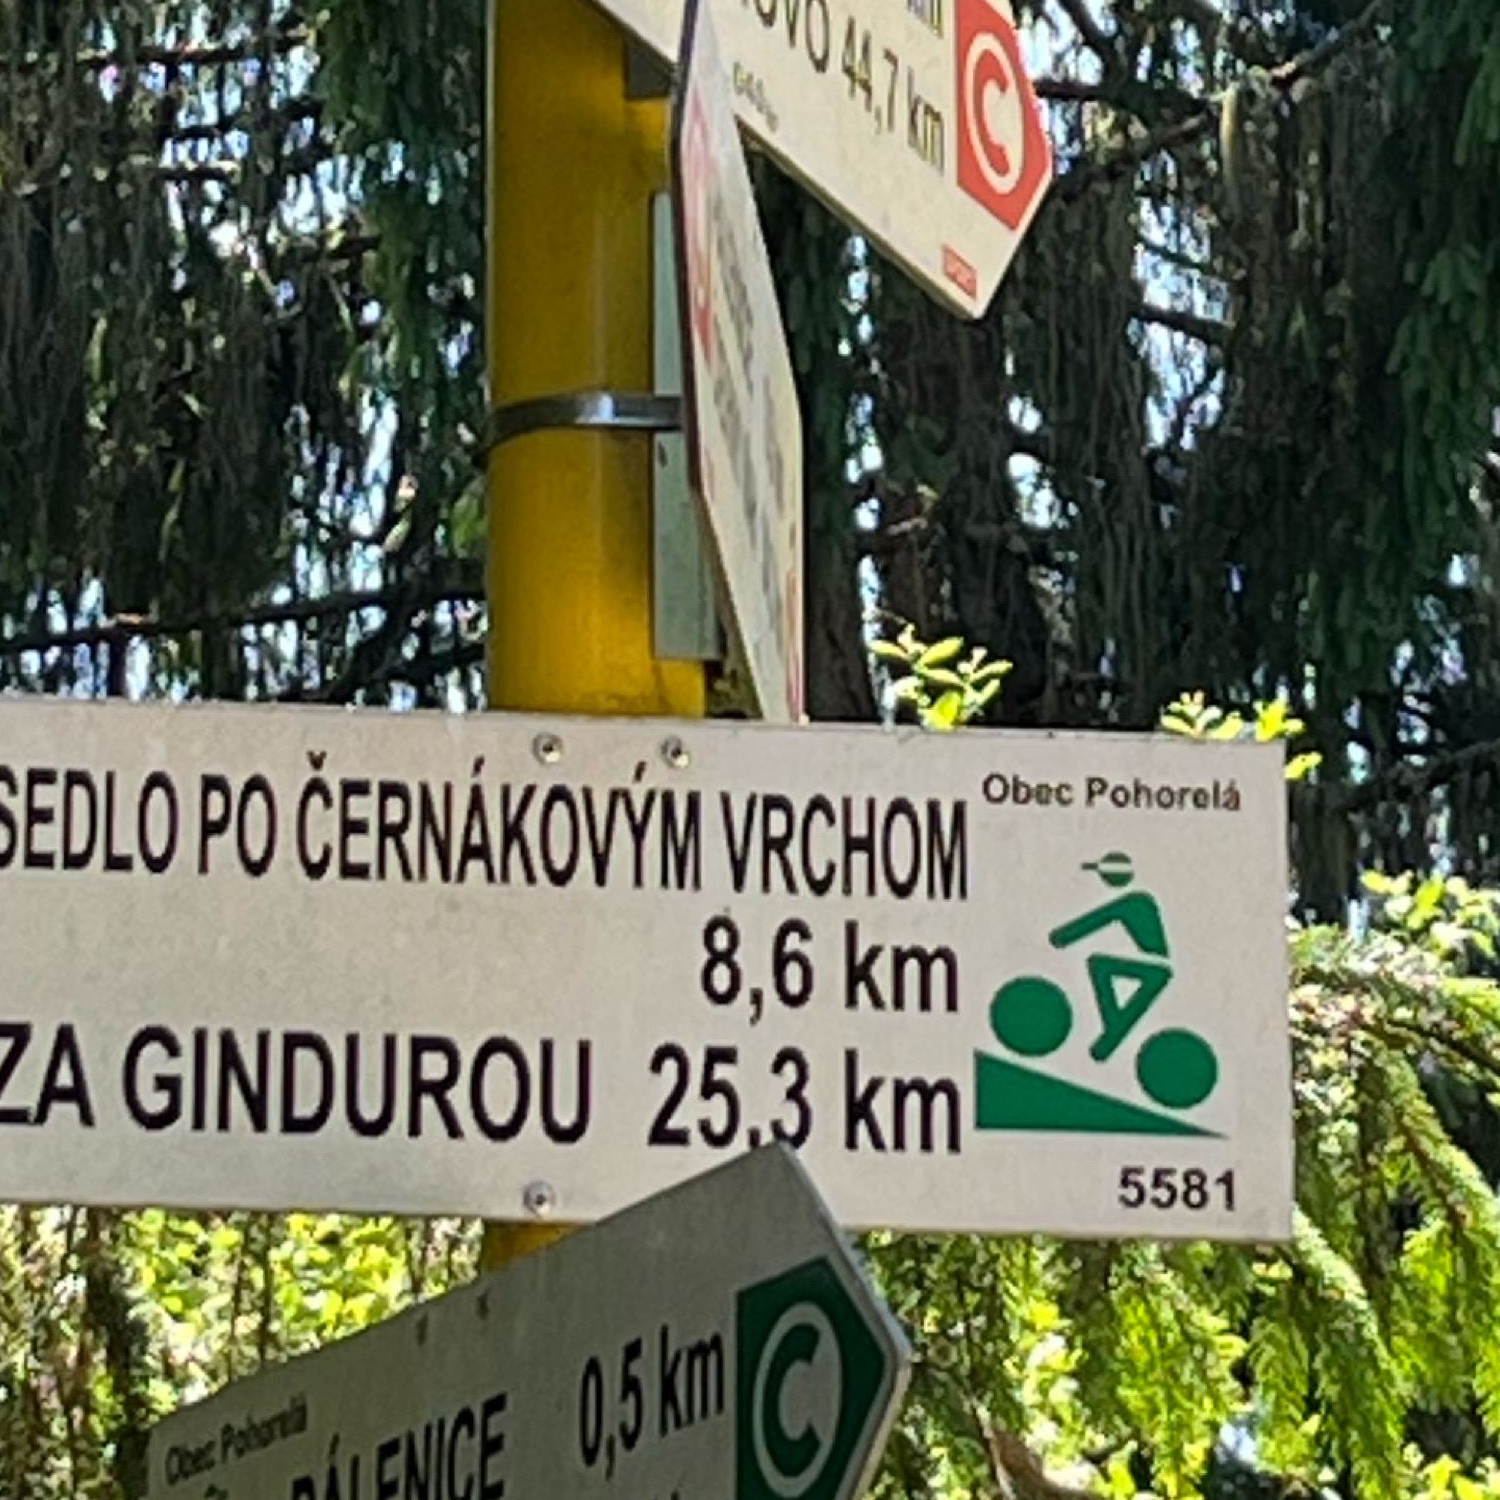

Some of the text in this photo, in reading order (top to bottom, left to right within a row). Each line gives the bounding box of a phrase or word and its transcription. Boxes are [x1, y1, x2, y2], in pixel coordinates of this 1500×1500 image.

[841, 13, 899, 137] 44,7
[906, 63, 946, 177] km
[198, 774, 278, 877] PO
[297, 749, 702, 893] ČERNÁKOVÝM
[718, 791, 969, 901] VRCHOM
[982, 773, 1242, 812] Obec Pohorelá
[701, 914, 959, 1025] 8,6 km
[121, 1024, 593, 1145] GINDUROU
[843, 1048, 963, 1155] km
[1117, 1165, 1237, 1212] 5581
[579, 1338, 643, 1481] 0,5
[660, 1324, 725, 1438] km
